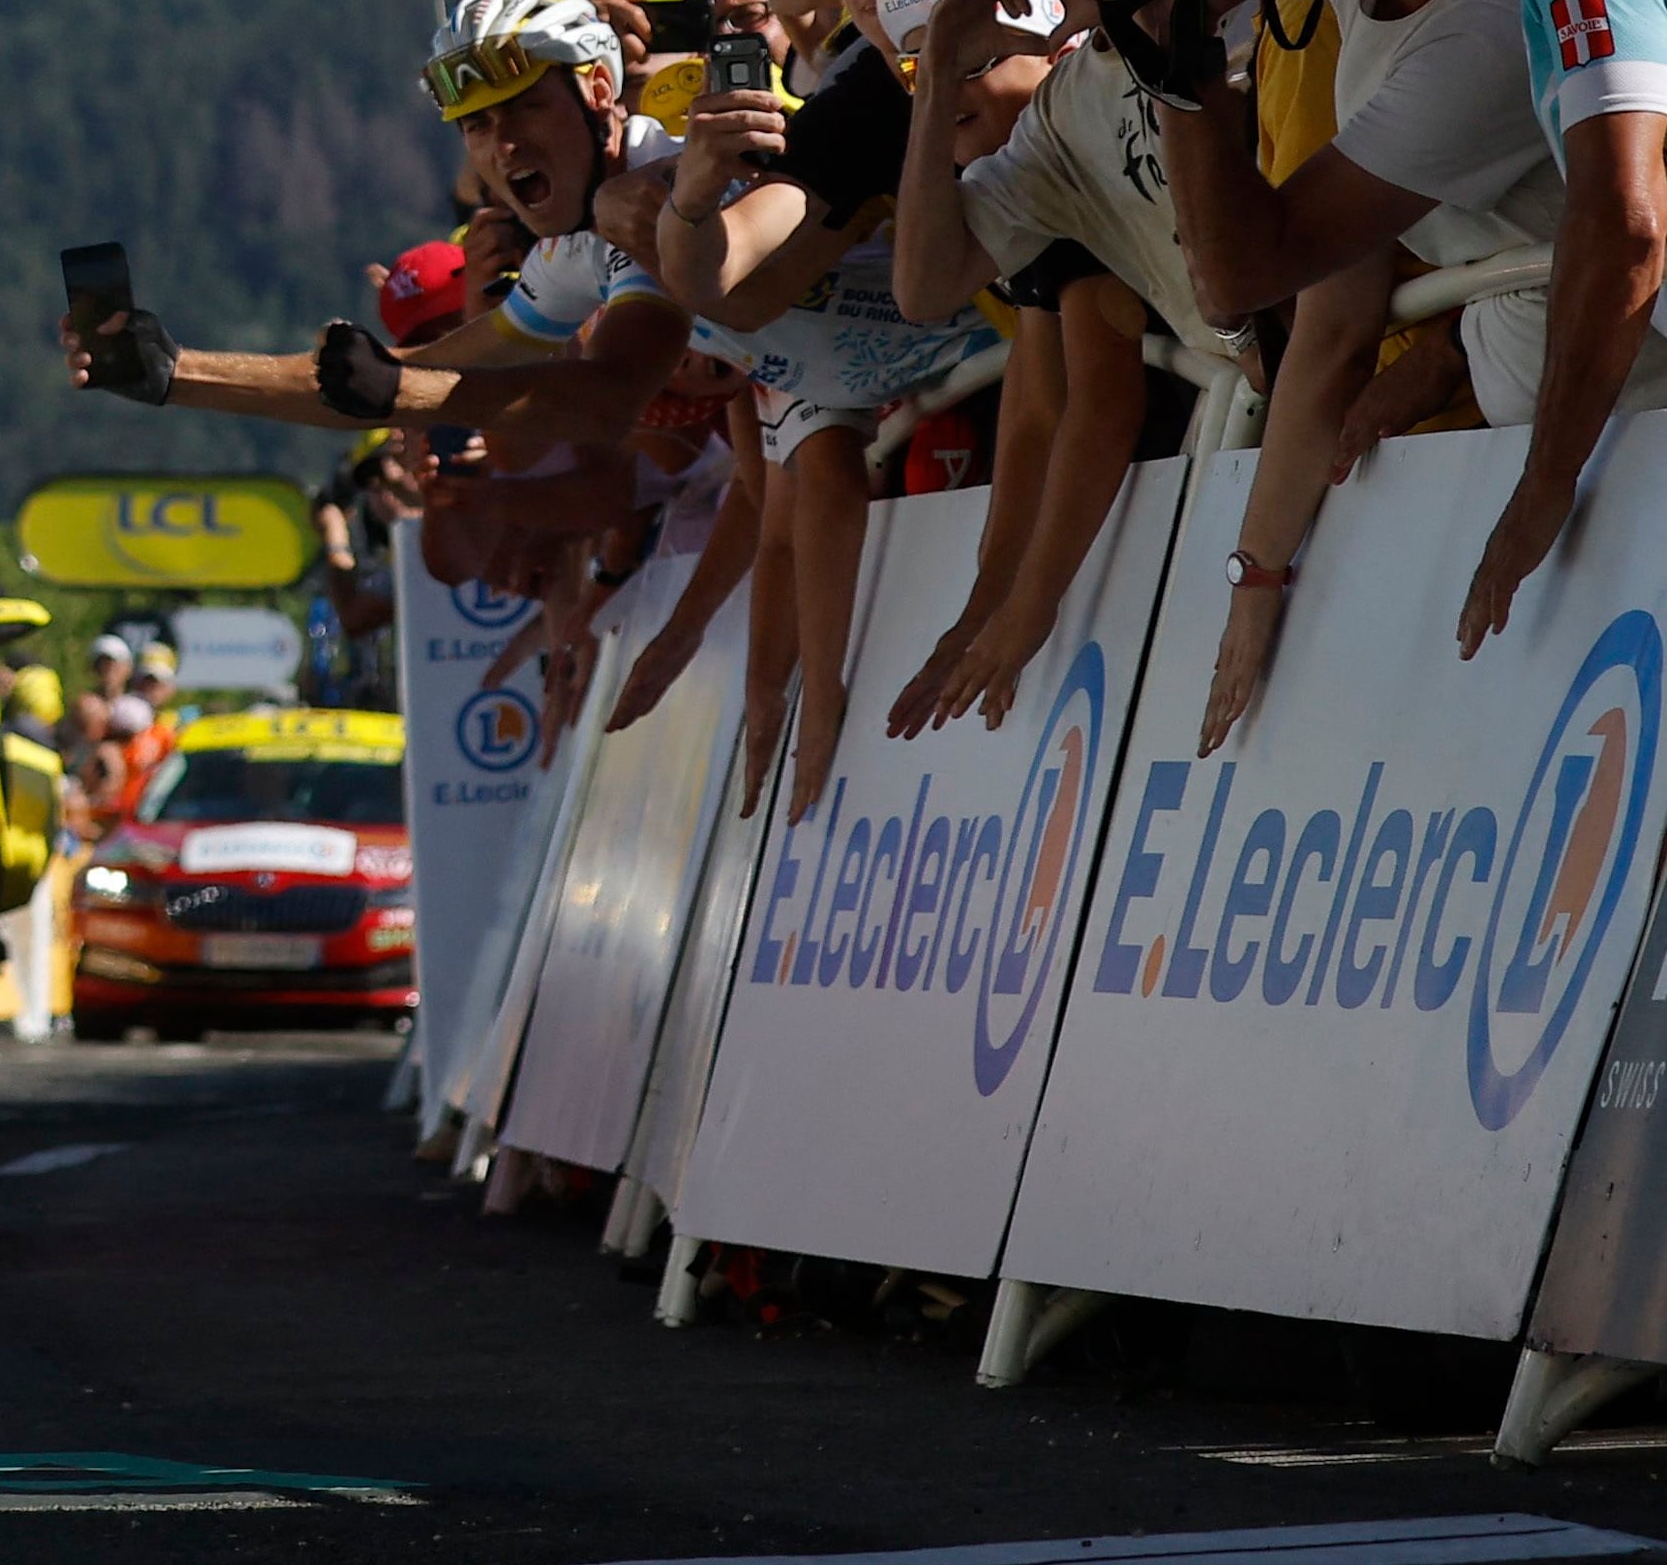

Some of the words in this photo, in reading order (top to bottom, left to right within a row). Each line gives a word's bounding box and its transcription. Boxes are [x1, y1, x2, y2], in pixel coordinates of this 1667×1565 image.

[1561, 20, 1603, 39] SAVOIE
[117, 492, 242, 536] LCL
[751, 773, 1005, 993] E.Leclerc
[1093, 760, 1498, 1012] E.Leclerc
[1600, 1059, 1667, 1109] SWISS
